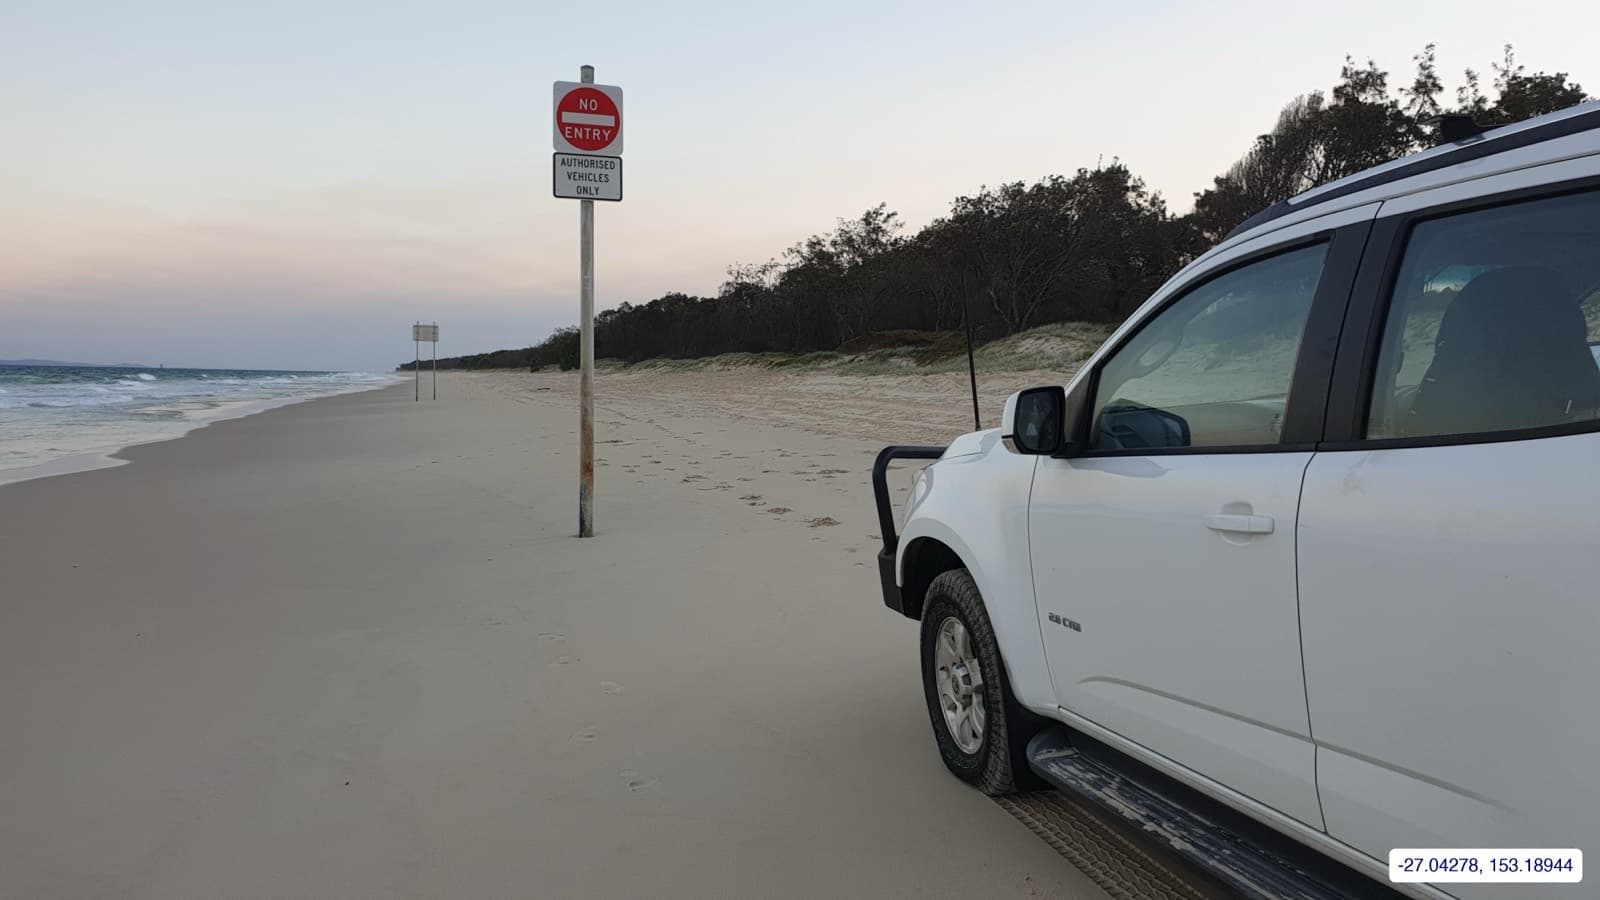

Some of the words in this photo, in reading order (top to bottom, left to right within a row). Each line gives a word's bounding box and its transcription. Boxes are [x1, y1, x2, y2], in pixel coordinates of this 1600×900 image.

[579, 98, 598, 111] NO
[565, 126, 611, 141] ENTRY
[560, 157, 616, 170] AUTHORISED
[567, 171, 610, 183] VEHICLES
[576, 185, 600, 196] ONLY
